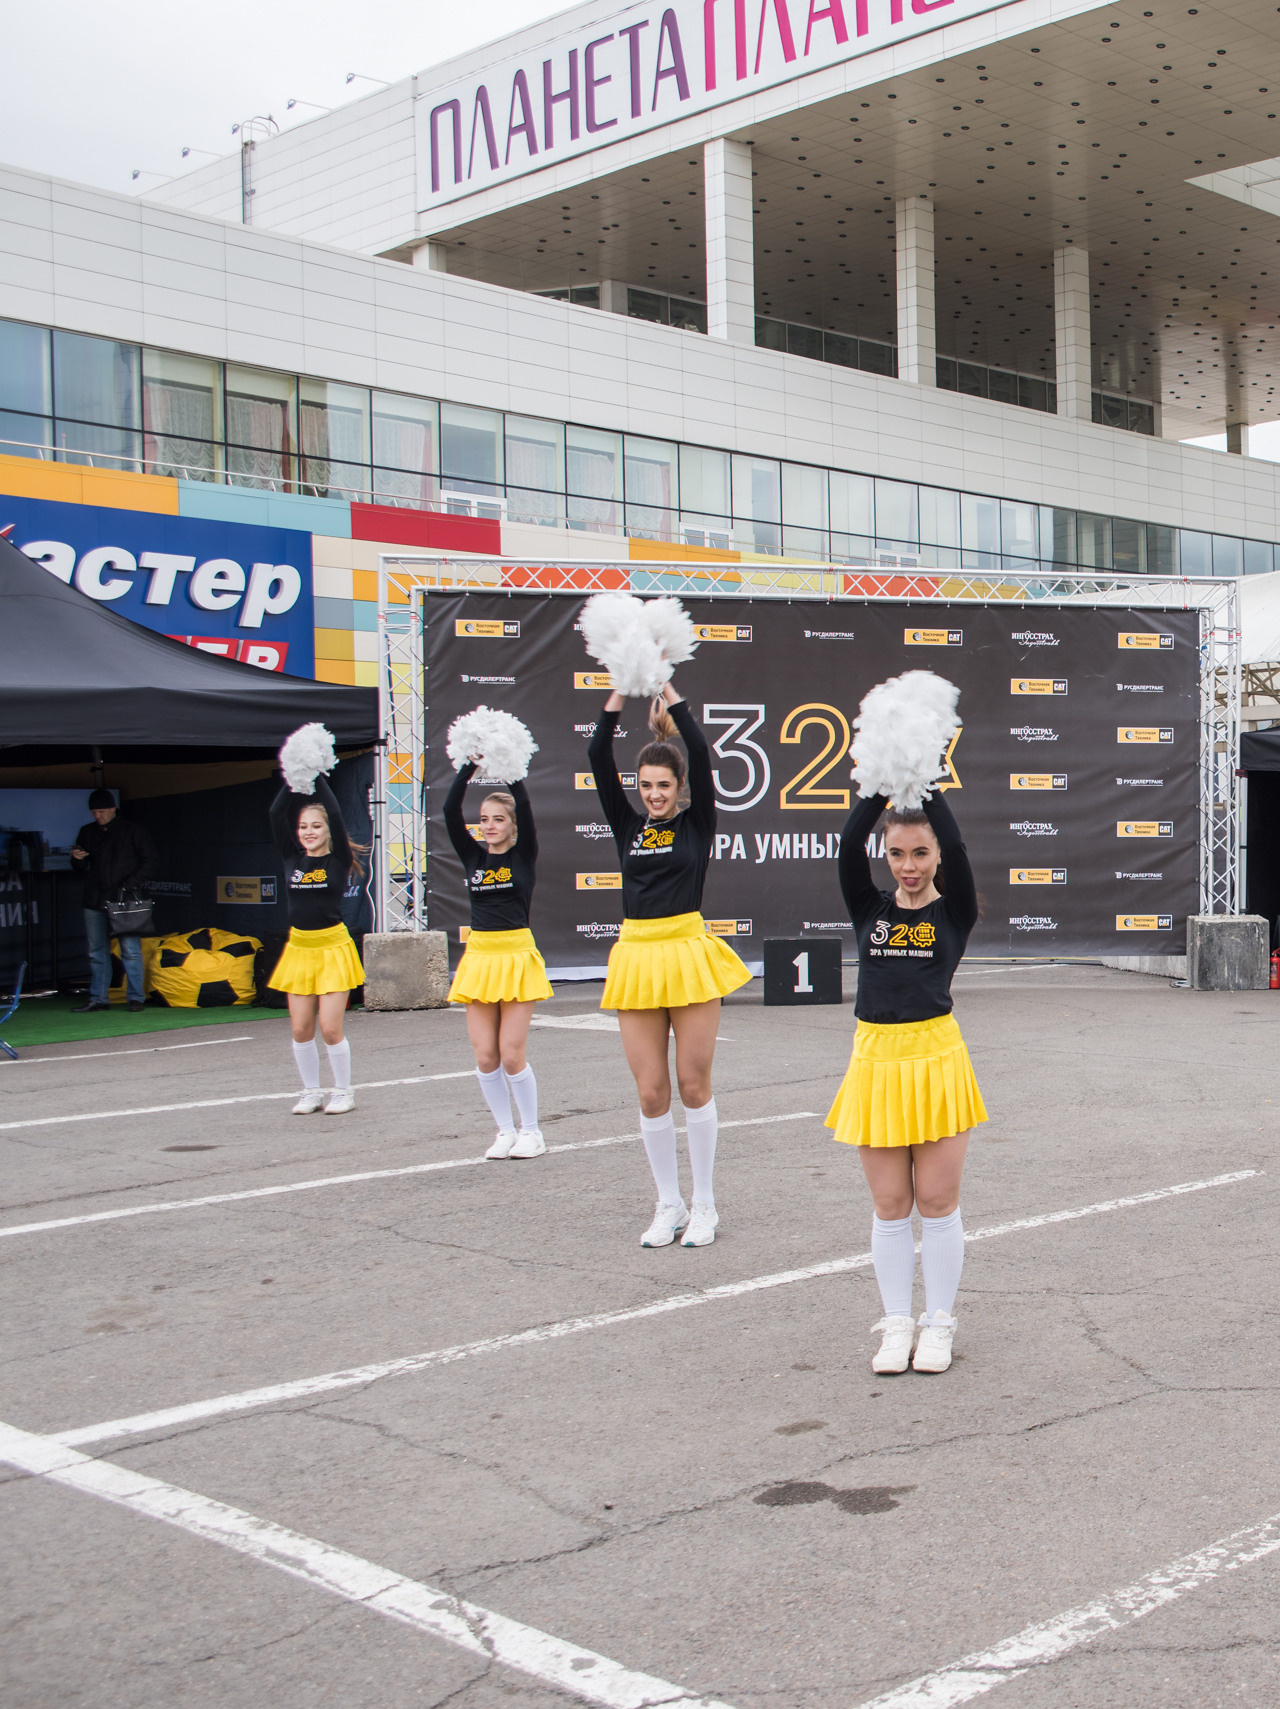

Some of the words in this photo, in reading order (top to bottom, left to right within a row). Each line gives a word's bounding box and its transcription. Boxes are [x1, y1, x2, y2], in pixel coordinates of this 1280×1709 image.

[703, 0, 952, 91] ПЛА
[430, 8, 691, 193] ПЛАНЕТА
[19, 540, 301, 627] астер
[504, 625, 518, 633] CAT
[737, 629, 750, 637] CAT
[1011, 630, 1054, 640] ИНГОССТРАХ
[1160, 637, 1172, 645] CAT
[1010, 726, 1053, 735] ИНГОССТРАХ
[1160, 732, 1171, 740] CAT
[622, 777, 635, 785] CAT
[1053, 778, 1065, 786] CAT
[1010, 821, 1052, 830] ИНГОССТРАХ
[710, 833, 747, 860] РА
[261, 884, 275, 896] CAT
[1009, 915, 1052, 924] ИНГОССТРАХ
[883, 949, 907, 957] УМНЫХ
[908, 950, 934, 958] МАШИН
[792, 952, 814, 993] 1
